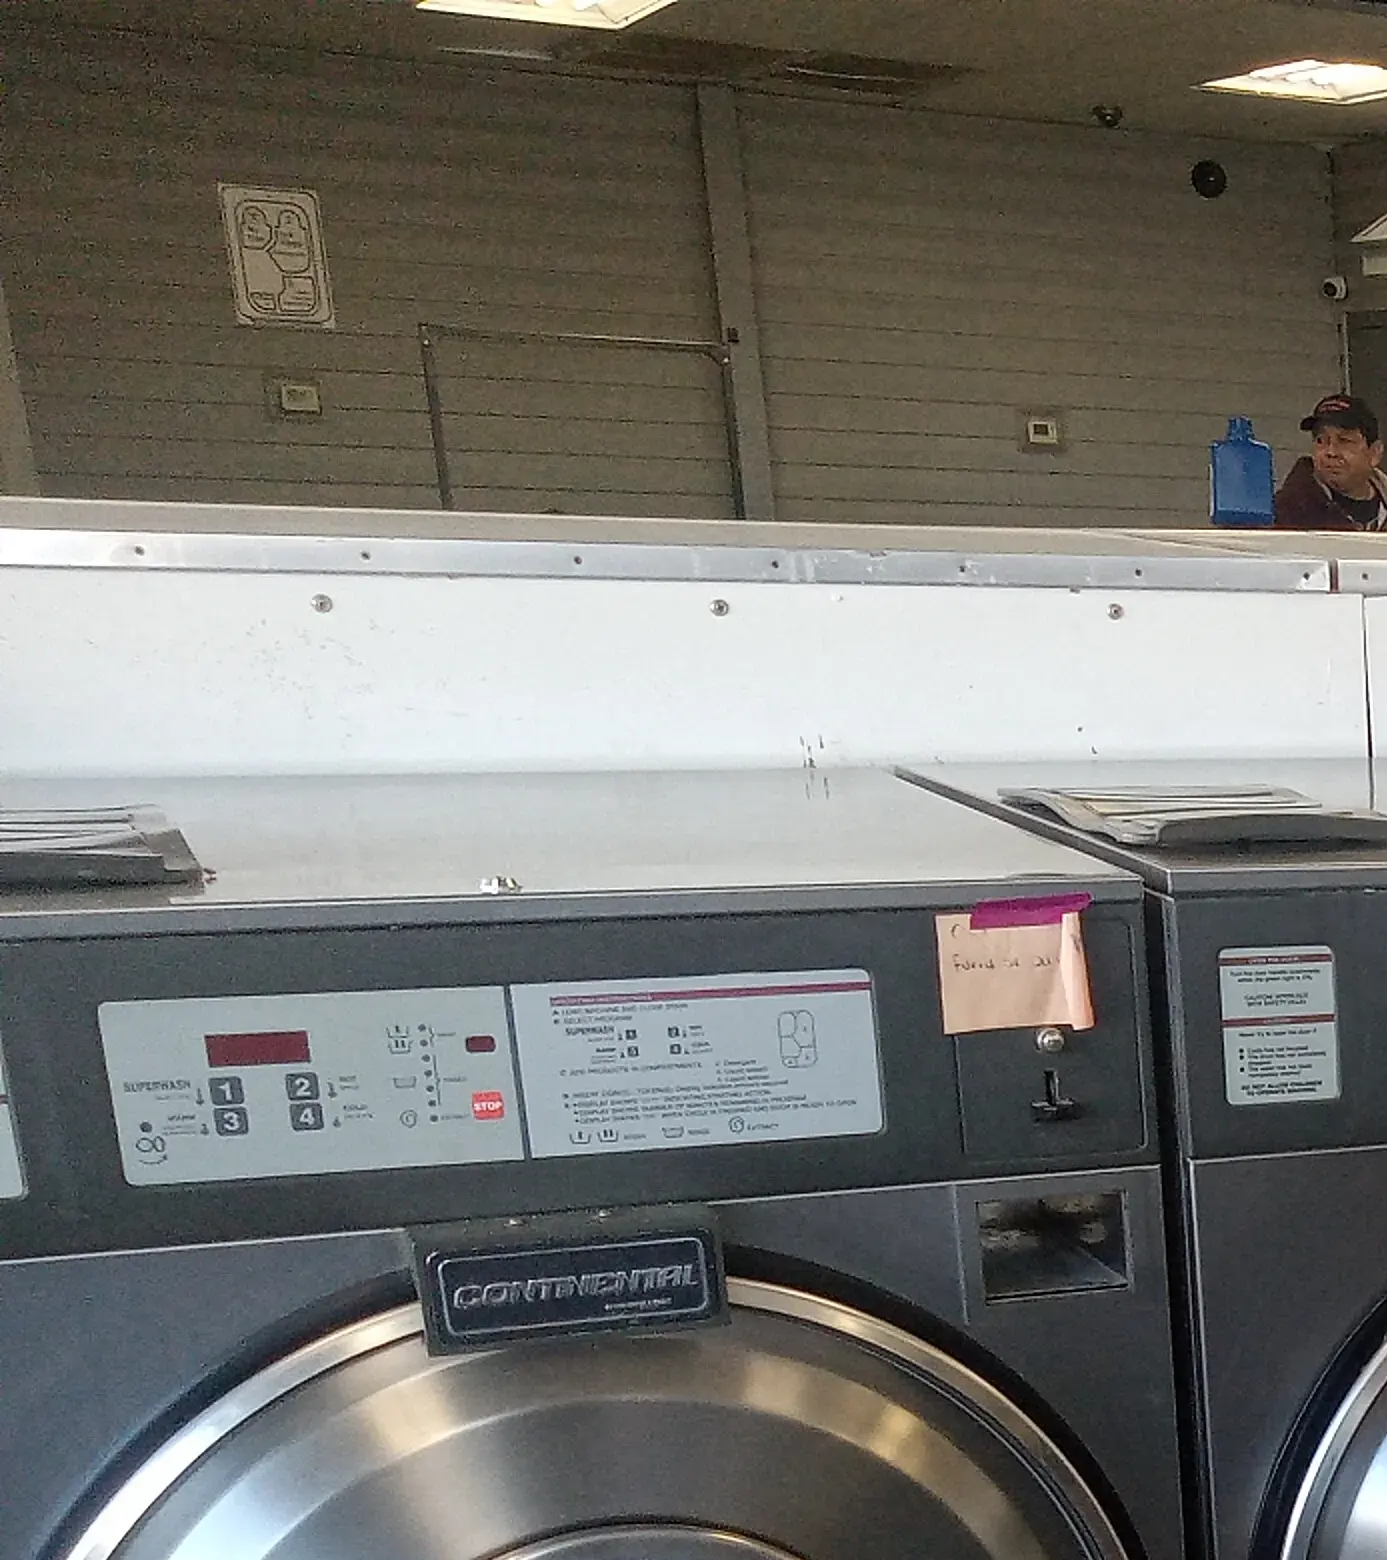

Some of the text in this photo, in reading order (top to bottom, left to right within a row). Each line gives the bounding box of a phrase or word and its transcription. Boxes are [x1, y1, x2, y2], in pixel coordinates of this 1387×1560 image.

[218, 1081, 233, 1101] 1
[295, 1078, 313, 1096] 2
[474, 1100, 503, 1112] STOP
[223, 1112, 240, 1131] 3
[299, 1108, 315, 1125] 4
[453, 1263, 699, 1310] CONTINENTAL
